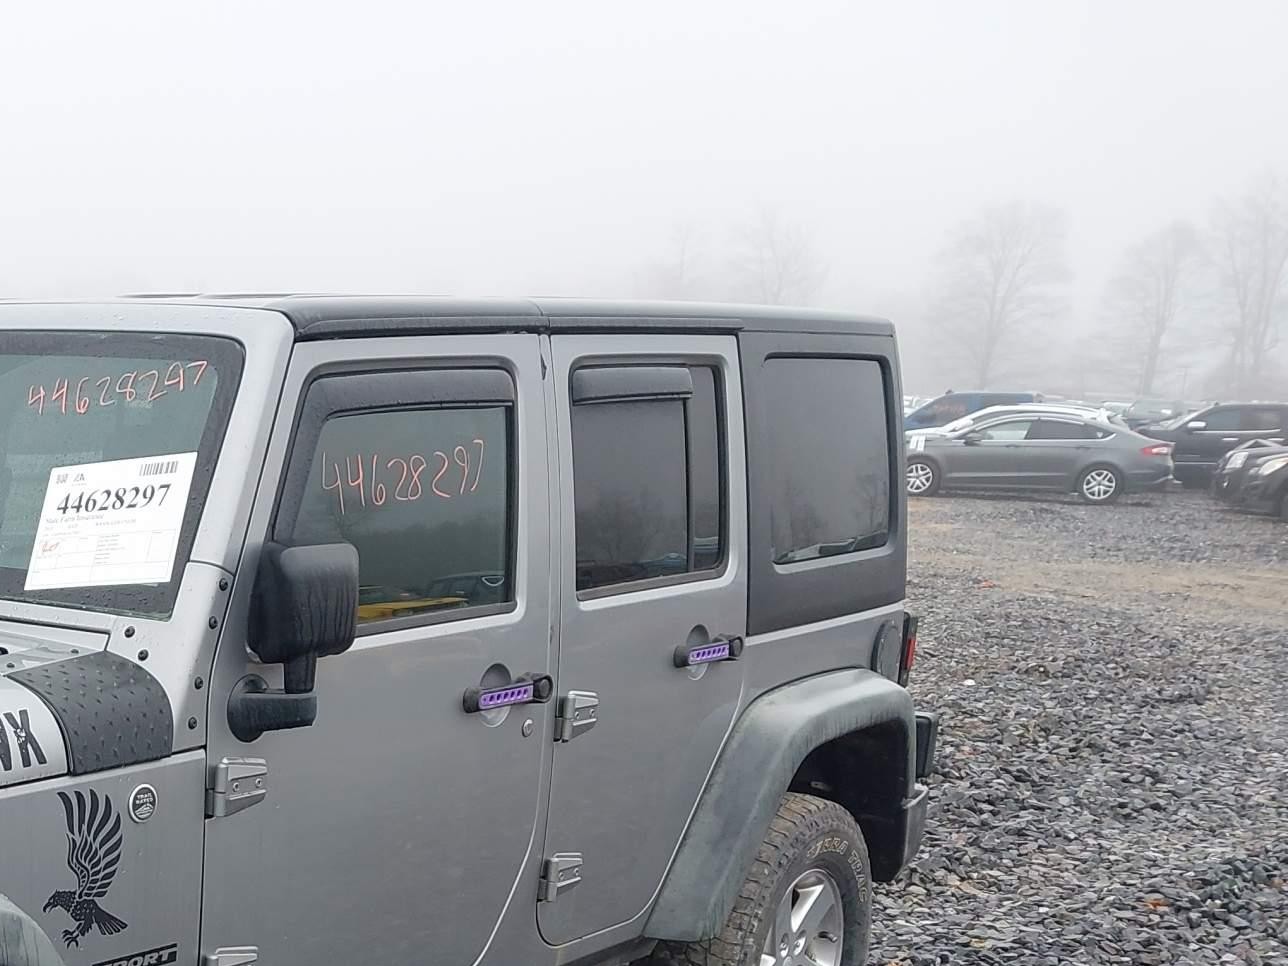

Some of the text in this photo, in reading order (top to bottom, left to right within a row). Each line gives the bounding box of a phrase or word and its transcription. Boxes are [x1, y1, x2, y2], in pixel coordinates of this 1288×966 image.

[28, 360, 208, 415] 44628297
[56, 483, 172, 515] 44628297
[322, 439, 484, 515] 44628297
